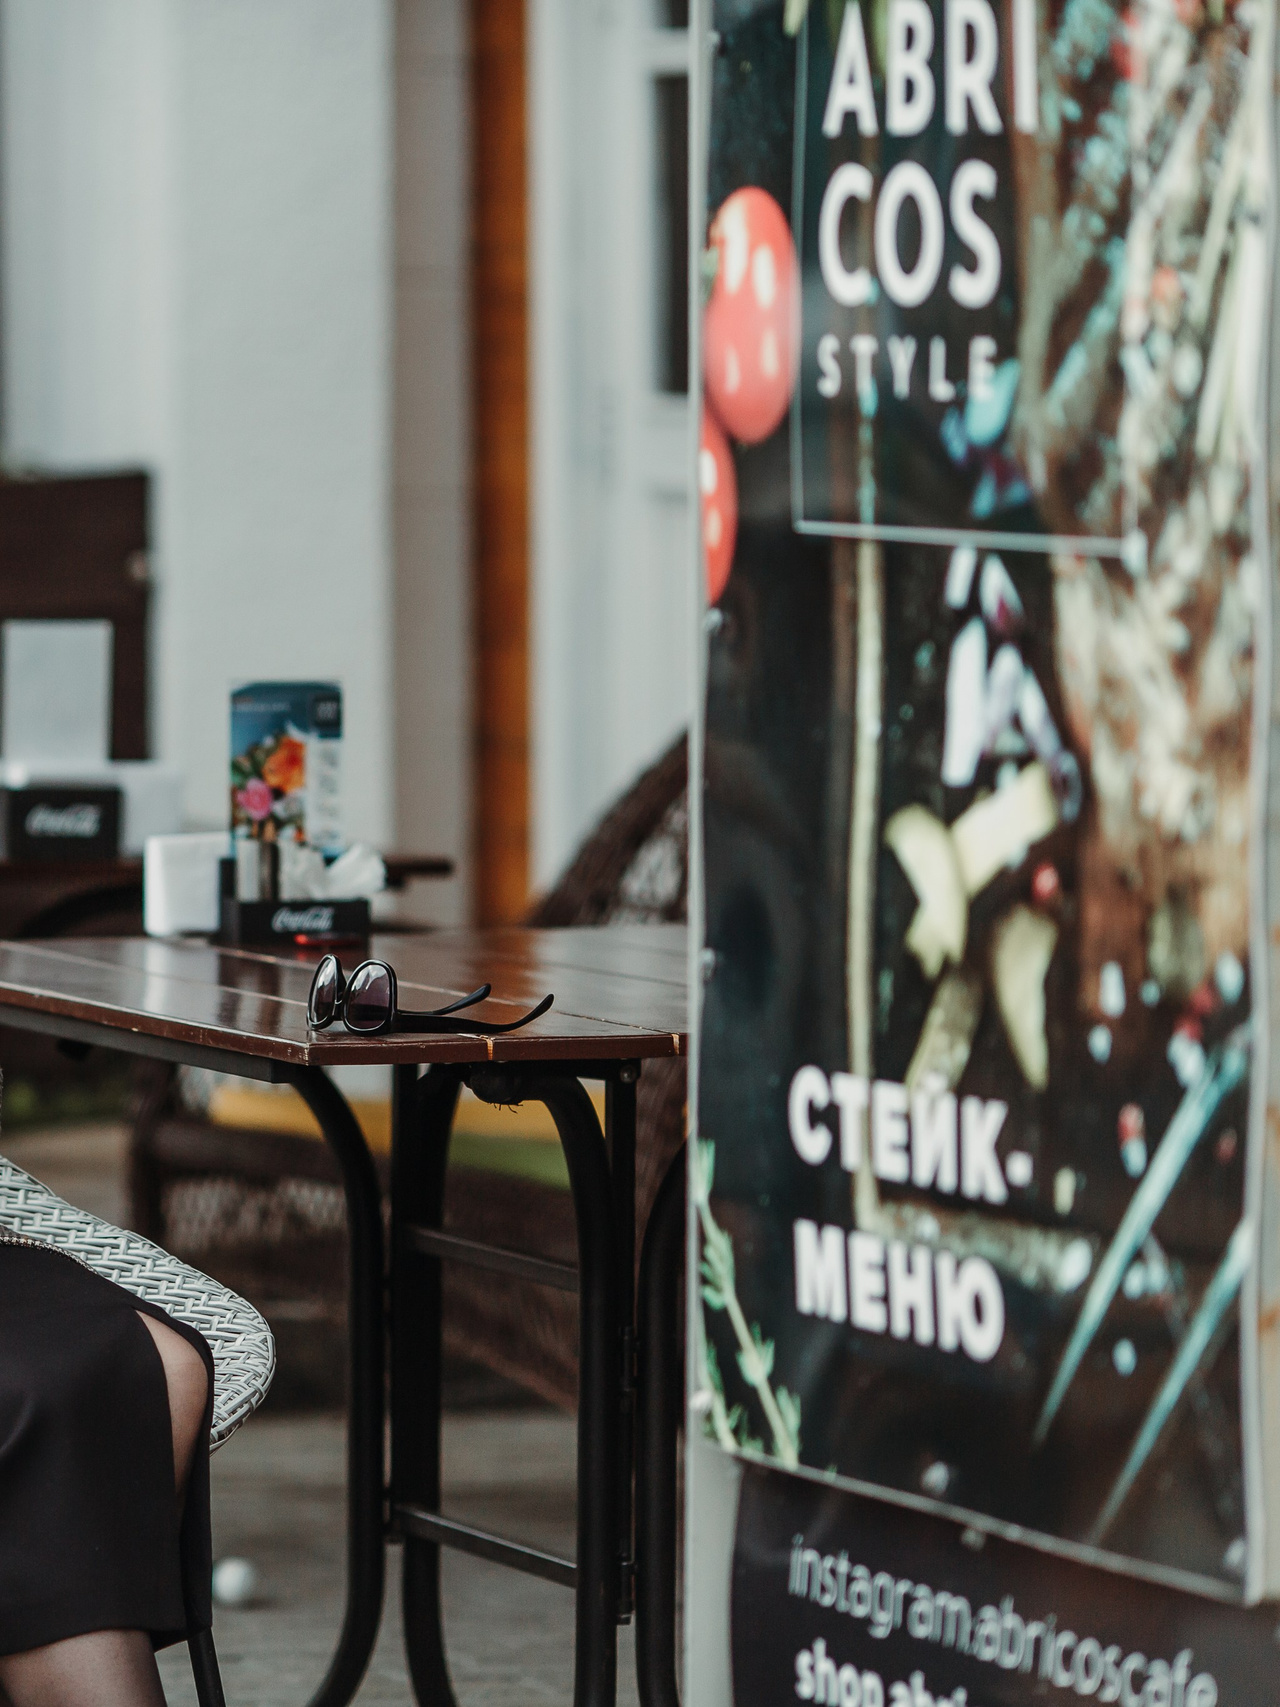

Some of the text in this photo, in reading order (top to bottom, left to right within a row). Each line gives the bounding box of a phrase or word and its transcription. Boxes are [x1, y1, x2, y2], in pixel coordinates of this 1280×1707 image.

[822, 0, 1039, 137] ABRI
[819, 160, 1002, 309] COS
[817, 335, 998, 402] STYLE
[793, 1219, 1004, 1362] МЕНЮ
